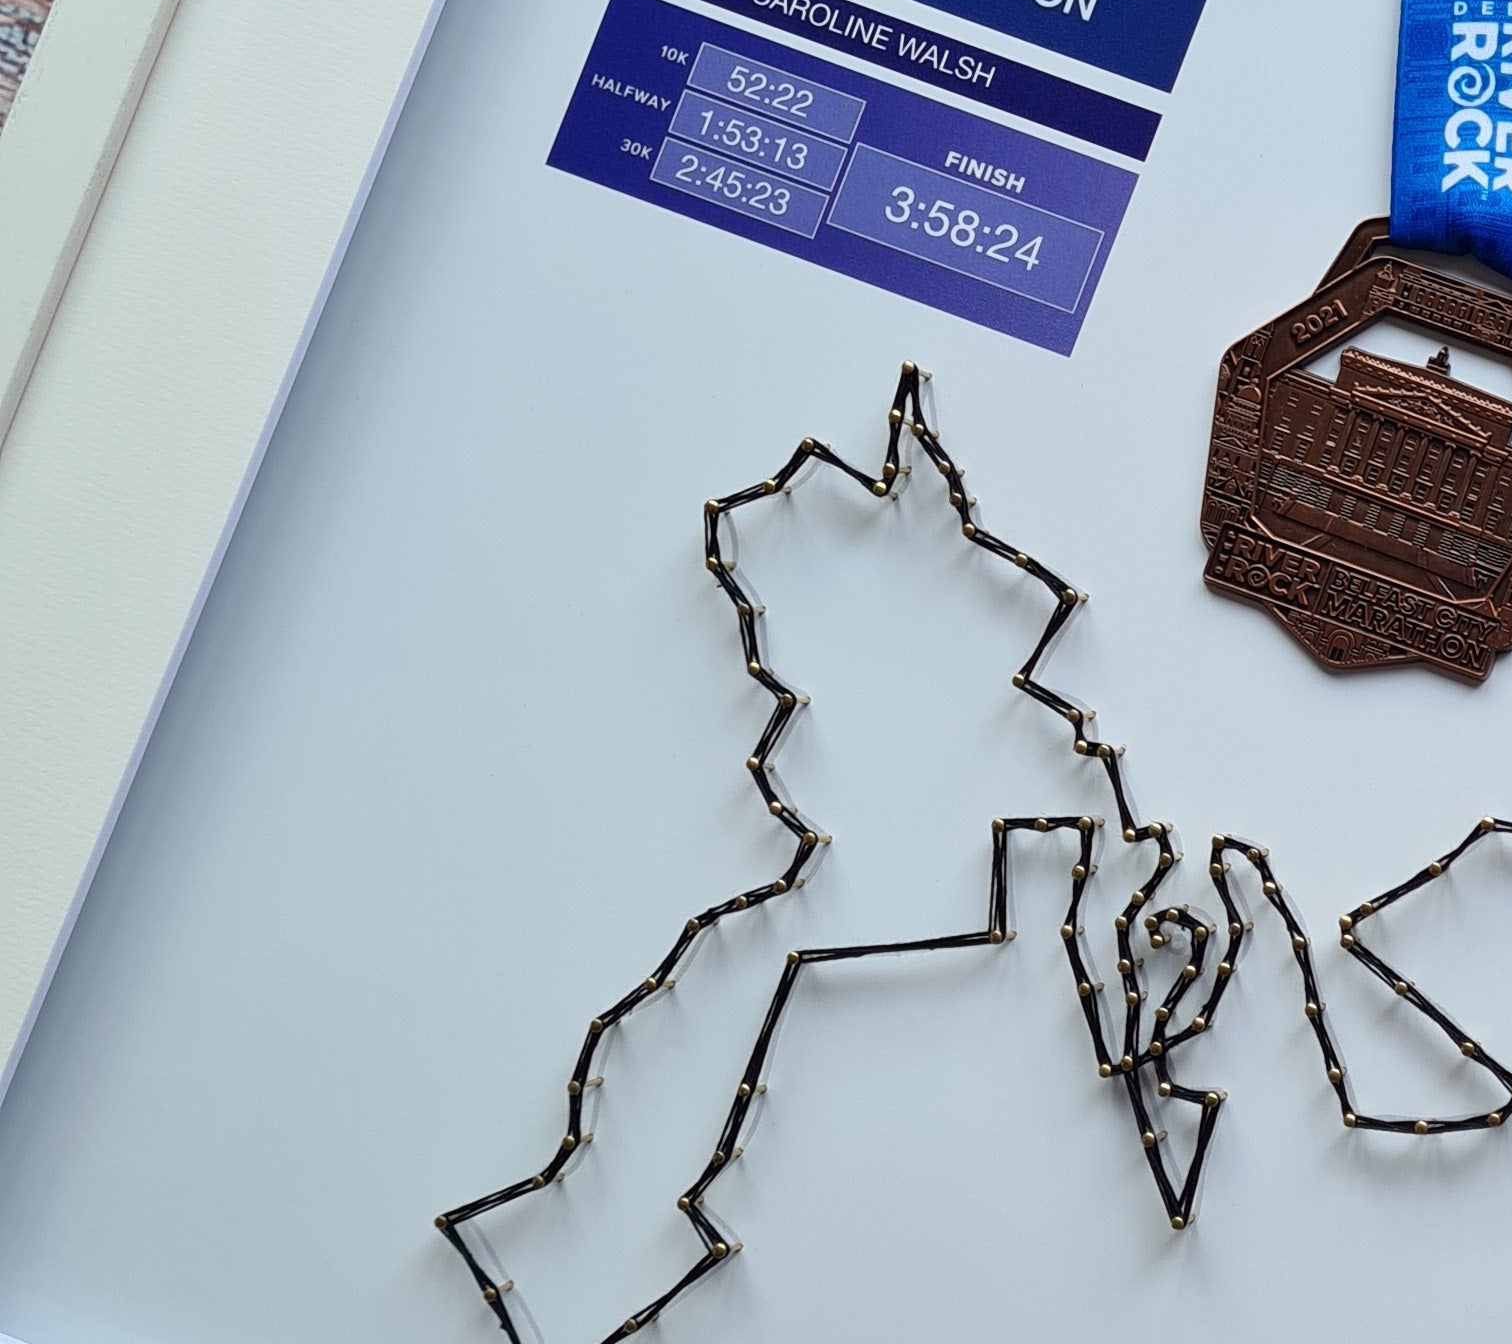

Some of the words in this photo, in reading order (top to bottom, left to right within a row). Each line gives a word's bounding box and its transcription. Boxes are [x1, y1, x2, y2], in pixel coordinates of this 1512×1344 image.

[660, 45, 690, 66] 10K
[898, 32, 996, 88] WALSH
[591, 73, 672, 112] HALFWAY
[727, 65, 814, 118] 52:22
[1441, 22, 1499, 192] ROCK
[620, 138, 653, 160] 30K
[699, 110, 808, 169] 1:53:13
[675, 154, 791, 215] 2:45:23
[944, 149, 1026, 194] FINISH
[884, 184, 1042, 272] 3:58:24
[1291, 299, 1350, 344] 2021
[1224, 556, 1310, 606] ROCK
[1232, 532, 1322, 584] RIVER
[1319, 590, 1488, 670] MARATHON
[1329, 569, 1432, 622] BELFAST
[1434, 606, 1500, 642] CITY
